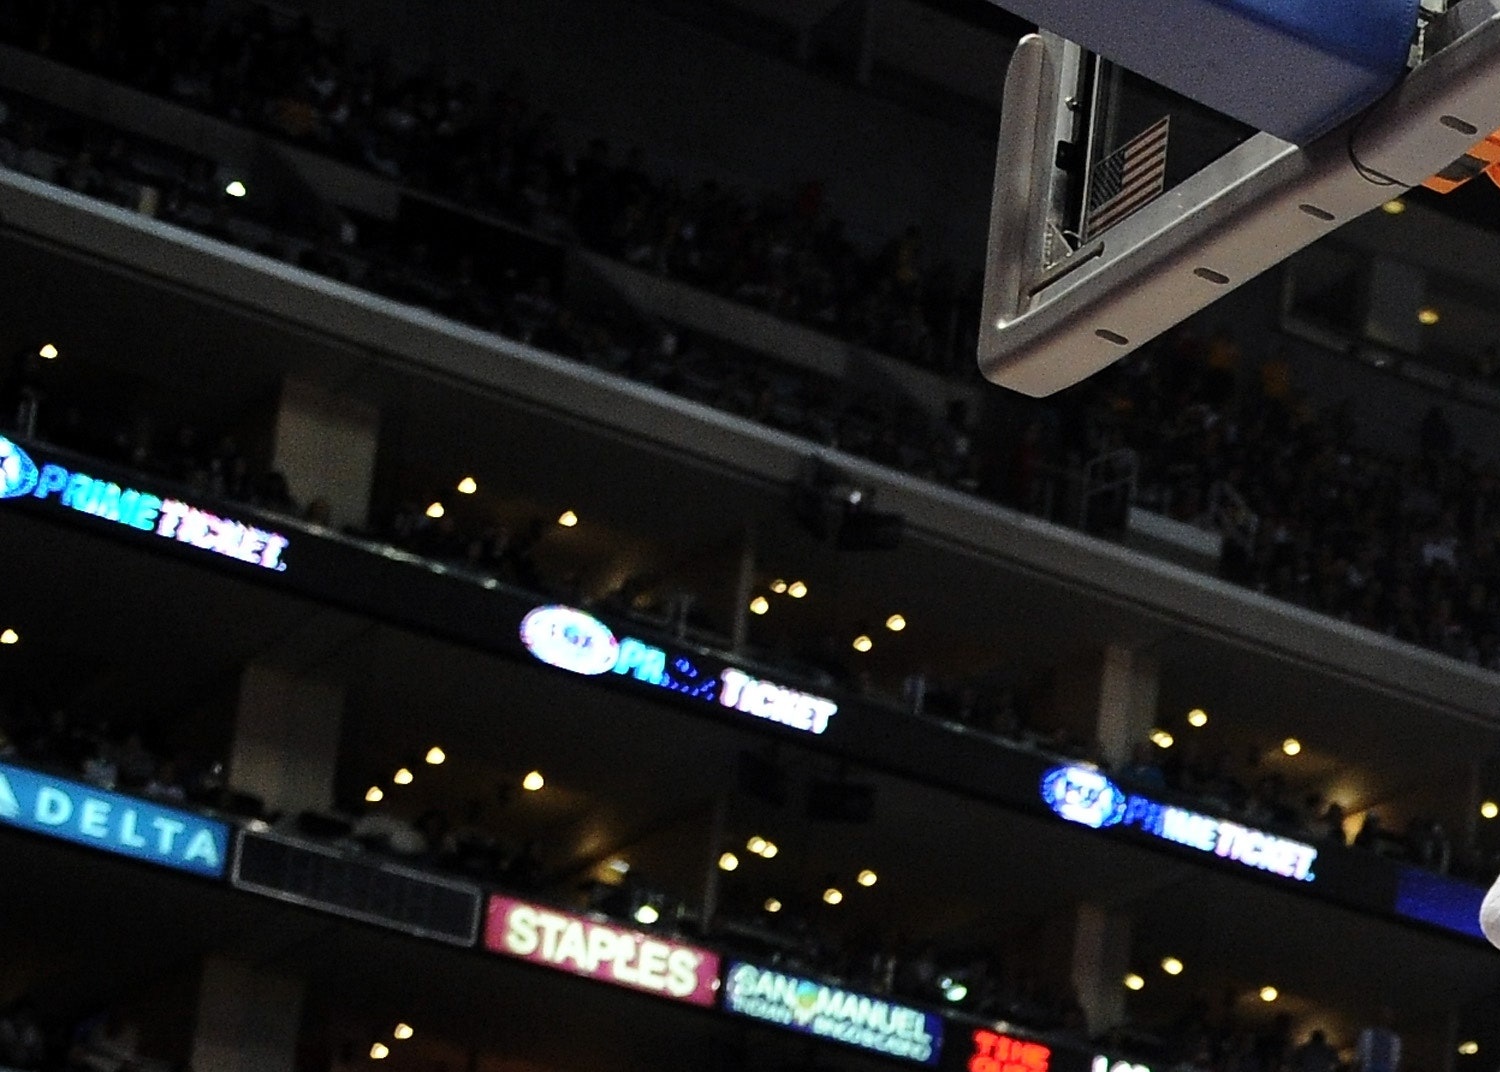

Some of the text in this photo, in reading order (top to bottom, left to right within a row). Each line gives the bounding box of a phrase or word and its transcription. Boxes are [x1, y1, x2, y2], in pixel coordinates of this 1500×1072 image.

[34, 786, 220, 868] DELTA
[505, 906, 700, 998] STAPLES
[973, 1030, 1050, 1064] TIME
